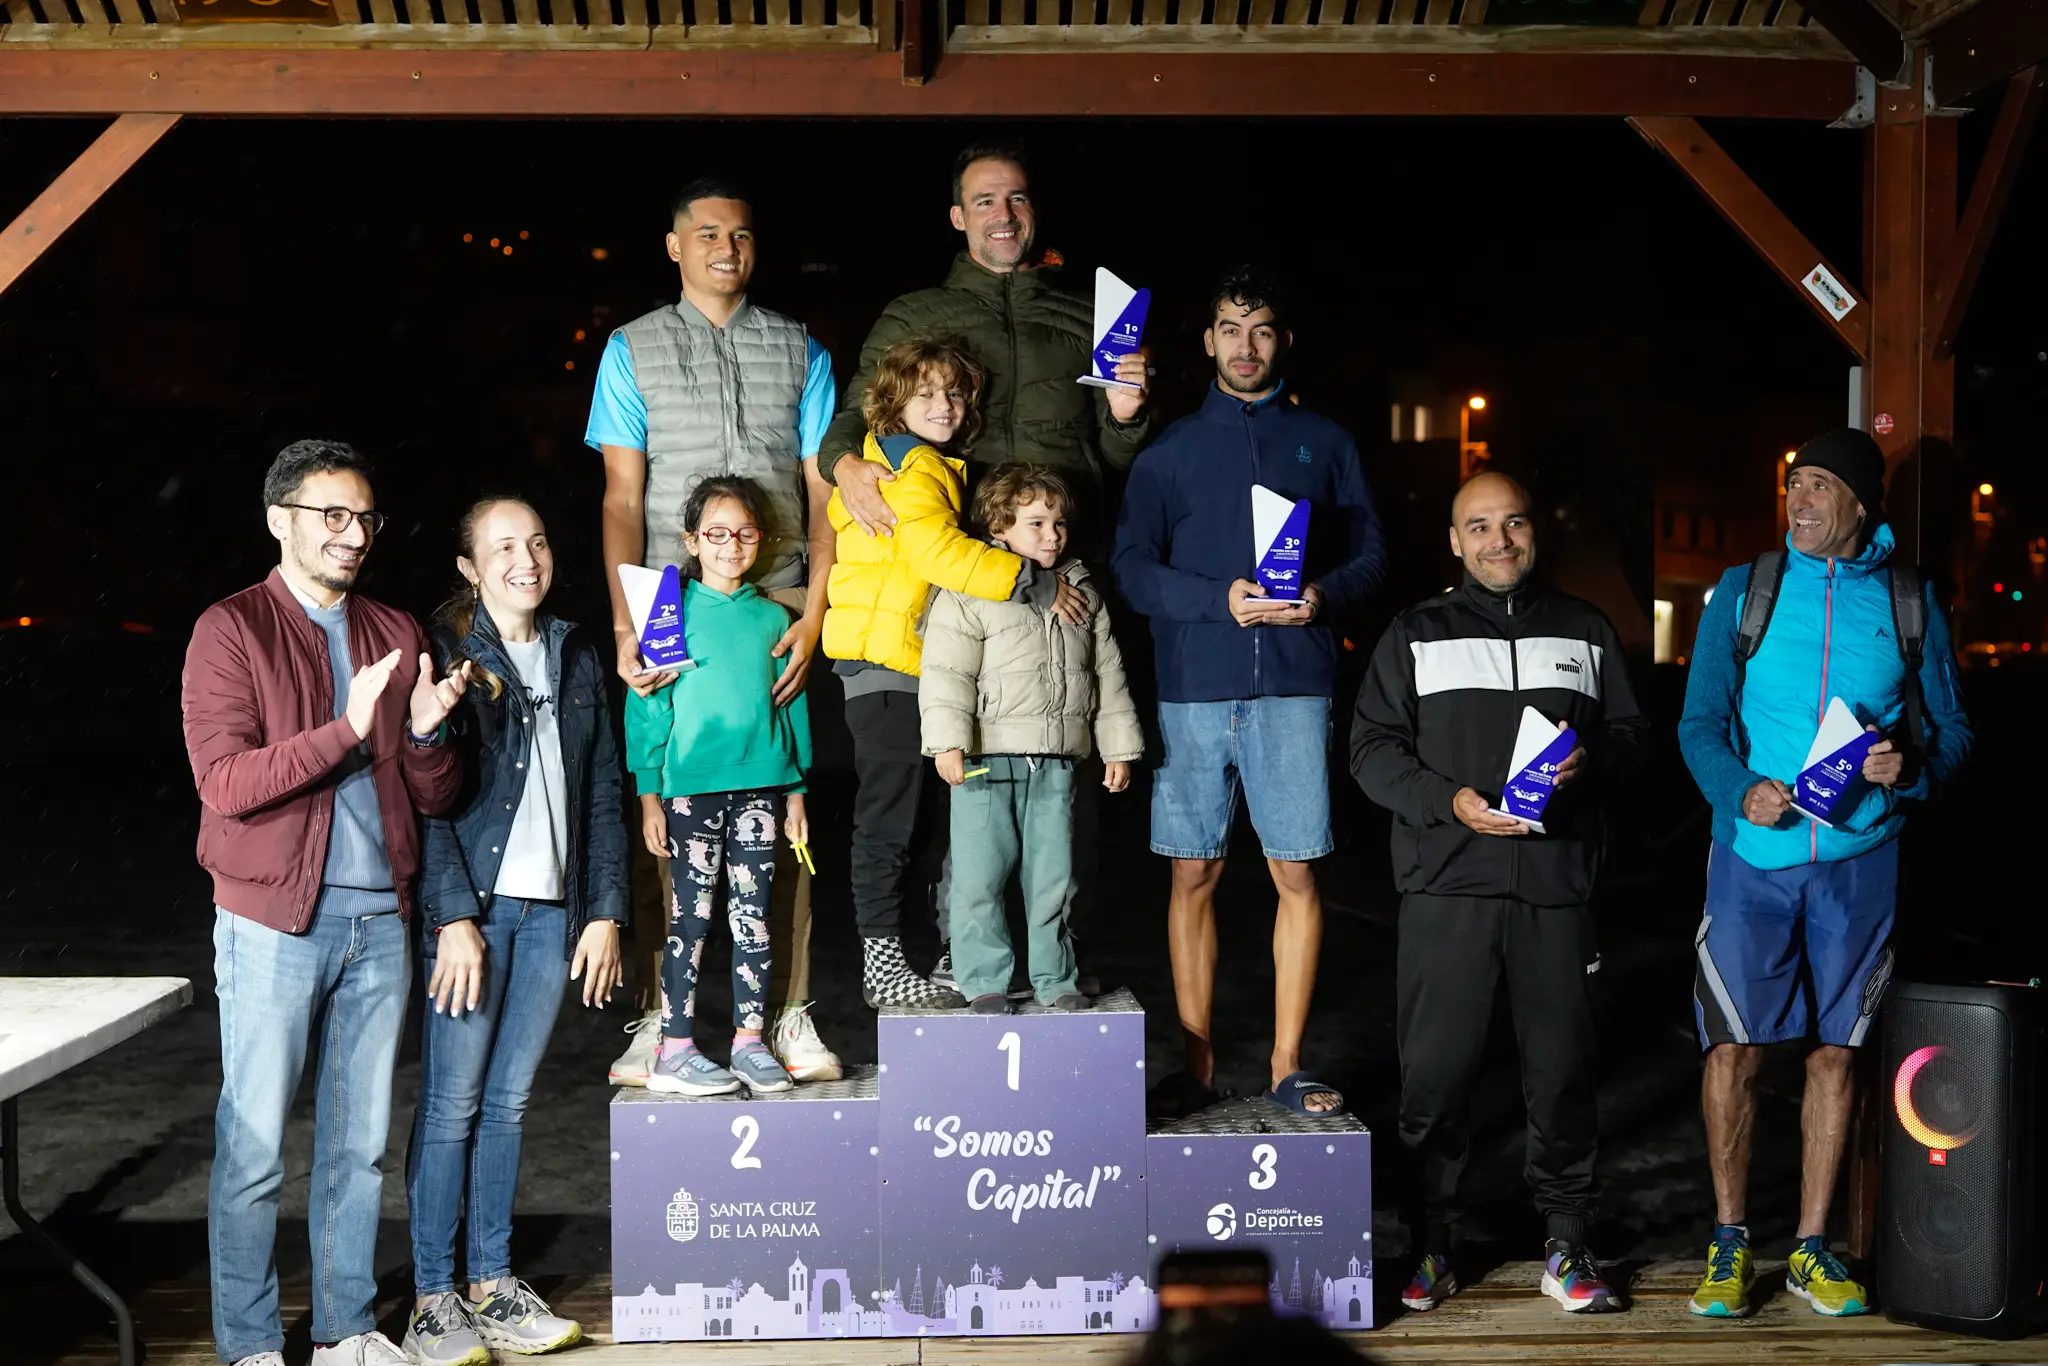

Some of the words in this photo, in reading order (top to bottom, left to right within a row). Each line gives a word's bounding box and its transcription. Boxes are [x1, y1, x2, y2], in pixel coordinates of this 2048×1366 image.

[1284, 537, 1300, 549] 3º
[660, 603, 676, 617] 2º
[1555, 662, 1580, 675] PUMA
[1539, 762, 1556, 774] 4º
[1835, 758, 1852, 771] 5º
[997, 1031, 1021, 1091] 1
[730, 1115, 762, 1170] 2
[913, 1115, 1054, 1158] “Somos
[1932, 1152, 1944, 1162] JBL
[1249, 1143, 1278, 1191] 3
[966, 1165, 1122, 1225] Capital”
[709, 1202, 765, 1218] SANTA
[769, 1201, 817, 1217] CRUZ
[1256, 1207, 1291, 1216] Concejalía
[709, 1224, 731, 1239] DE
[736, 1223, 757, 1238] LA
[761, 1222, 821, 1238] PALMA
[1245, 1213, 1324, 1232] Deportes
